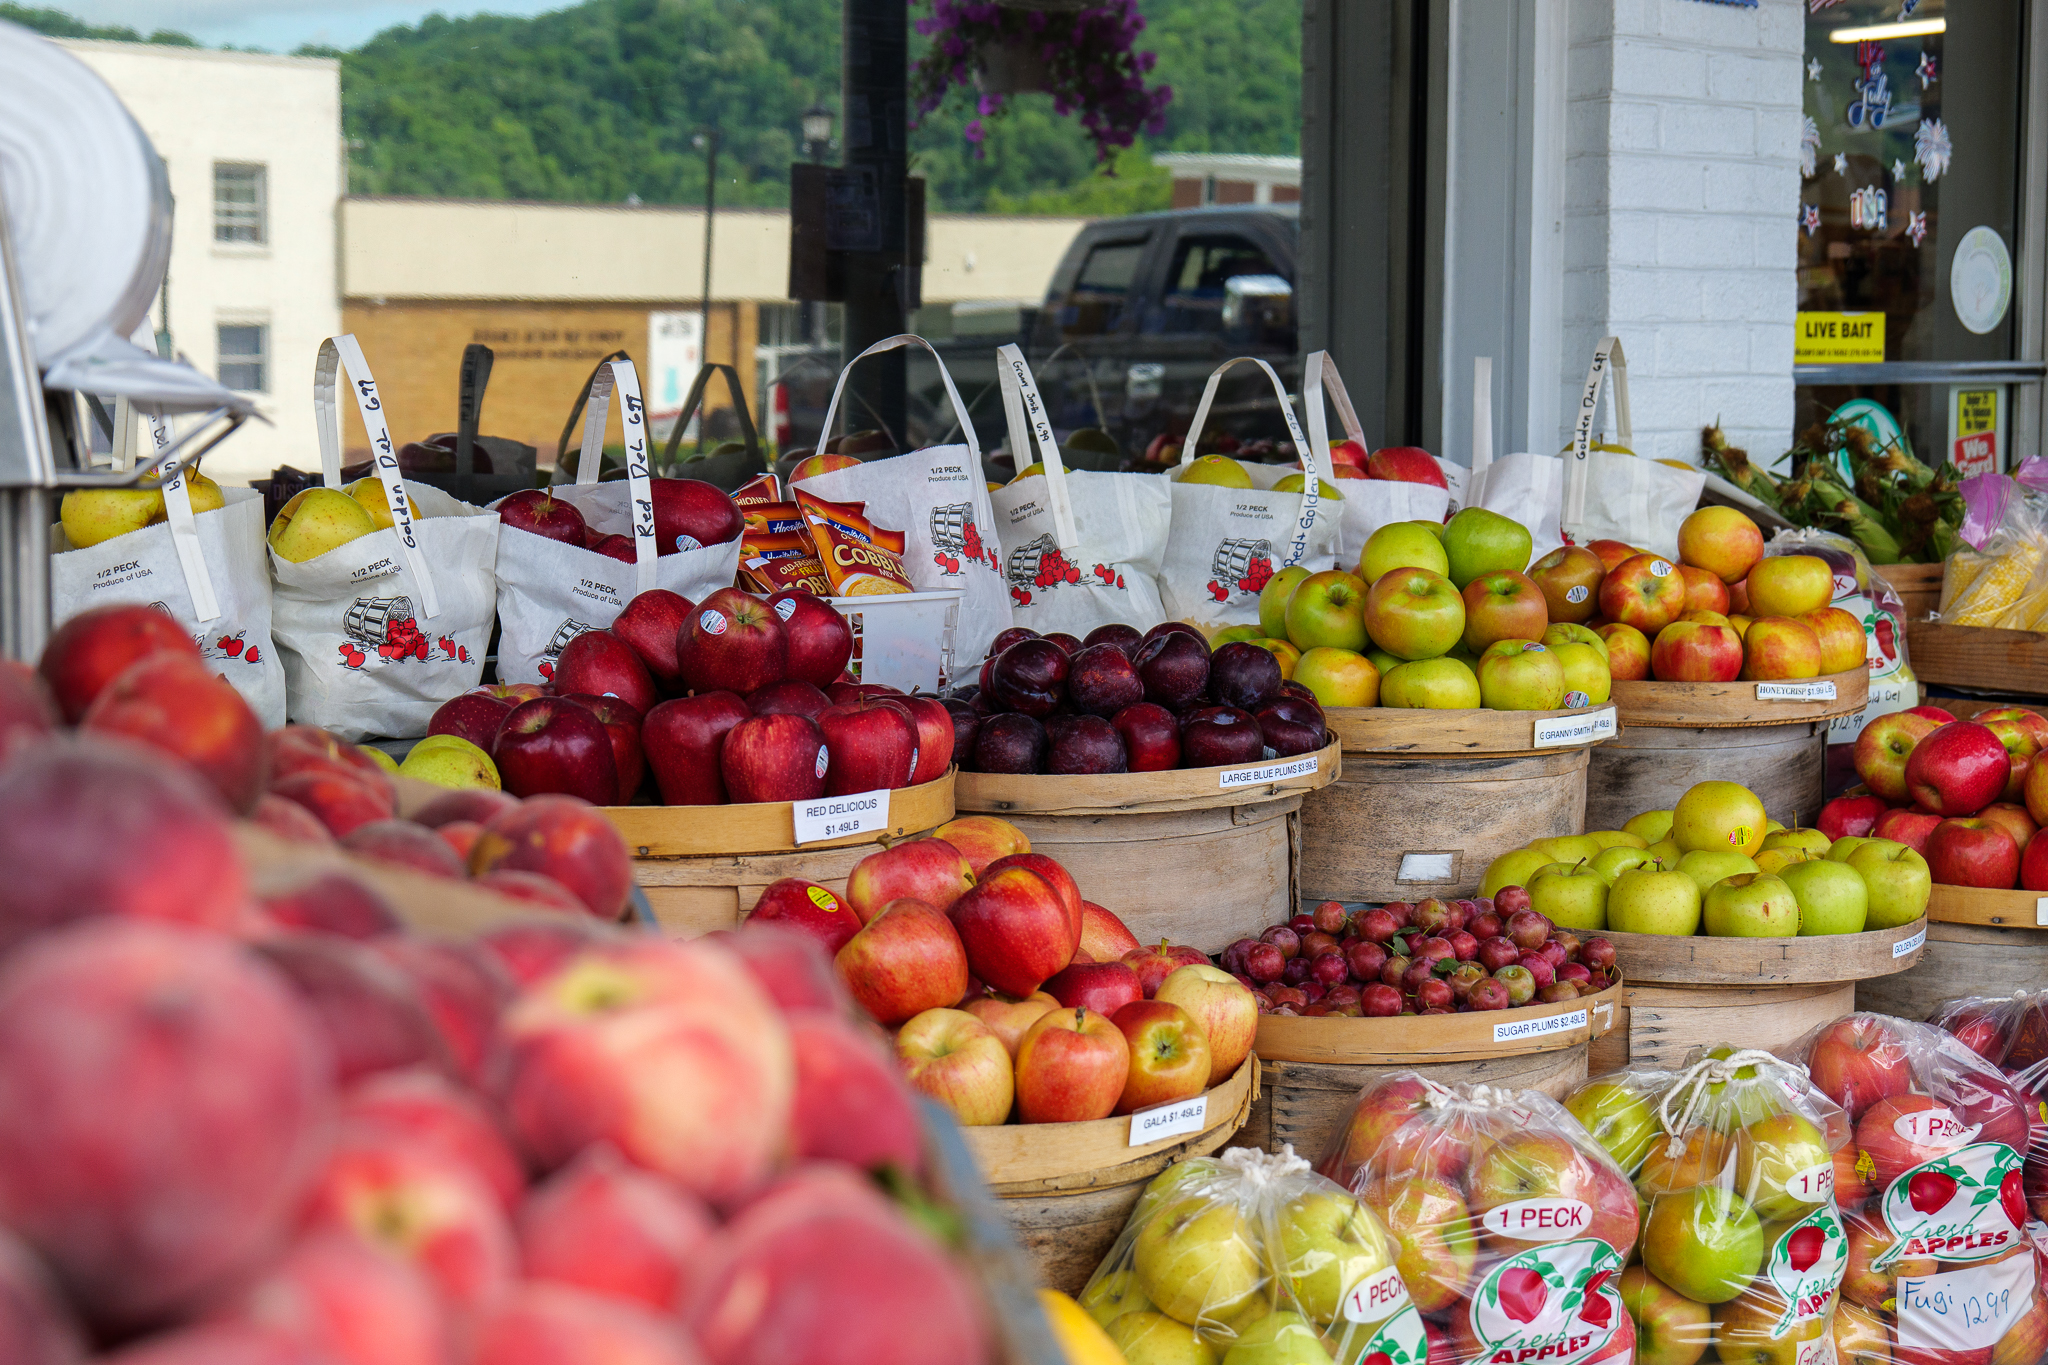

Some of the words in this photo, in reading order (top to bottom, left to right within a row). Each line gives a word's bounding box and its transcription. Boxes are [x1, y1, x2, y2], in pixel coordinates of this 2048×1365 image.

[1805, 321, 1836, 338] LIVE
[1841, 321, 1873, 338] BAIT
[153, 425, 170, 450] Del
[1036, 422, 1050, 442] 6.99
[1962, 438, 1989, 459] We
[1010, 507, 1020, 516] 1/2
[1020, 501, 1037, 514] PECK
[1032, 507, 1045, 517] USA
[1299, 475, 1319, 530] Golden
[638, 498, 655, 538] Red
[1230, 511, 1253, 519] Produce
[97, 568, 112, 579] 1/2
[113, 560, 141, 574] PECK
[351, 567, 366, 578] 1/2
[367, 557, 393, 574] PECK
[878, 568, 896, 581] MIX
[92, 577, 125, 590] Produce
[125, 573, 135, 581] of
[134, 568, 154, 580] USA
[350, 574, 379, 585] Produce
[380, 571, 390, 579] of
[580, 578, 593, 589] 1/2
[593, 580, 618, 596] PECK
[572, 586, 600, 601] Produce
[600, 594, 609, 602] of
[608, 595, 624, 608] USA
[1759, 685, 1806, 695] HONEYCRISP
[1807, 686, 1824, 696] $1.99
[1825, 685, 1833, 694] LB
[1885, 690, 1900, 703] Del
[1830, 715, 1864, 731] $12.99
[1545, 729, 1573, 740] GRANNY
[1574, 726, 1590, 736] SMITH
[1222, 771, 1252, 784] LARGE
[1253, 768, 1274, 780] BLUE
[1274, 764, 1297, 777] PLUMS
[1298, 759, 1318, 774] $3.99LB
[806, 806, 827, 817] RED
[829, 798, 877, 815] DELICIOUS
[825, 820, 860, 835] $1.49LB
[1894, 941, 1912, 954] GOLDEN
[1497, 1024, 1530, 1038] SUGAR
[1531, 1018, 1560, 1033] PLUMS
[1560, 1012, 1586, 1028] $2.49LB
[1143, 1115, 1167, 1129] GALA
[1169, 1105, 1203, 1122] $1.49LB
[1909, 1117, 1918, 1135] 1
[1800, 1175, 1809, 1194] 1
[1499, 1208, 1508, 1228] 1
[1520, 1205, 1583, 1228] PECK
[1904, 1230, 2009, 1256] APPLES
[1353, 1291, 1363, 1313] 1
[1369, 1274, 1406, 1308] PECK
[1904, 1280, 1953, 1315] Fugi
[1962, 1288, 2010, 1329] 12.99
[1490, 1330, 1594, 1365] APPLES
